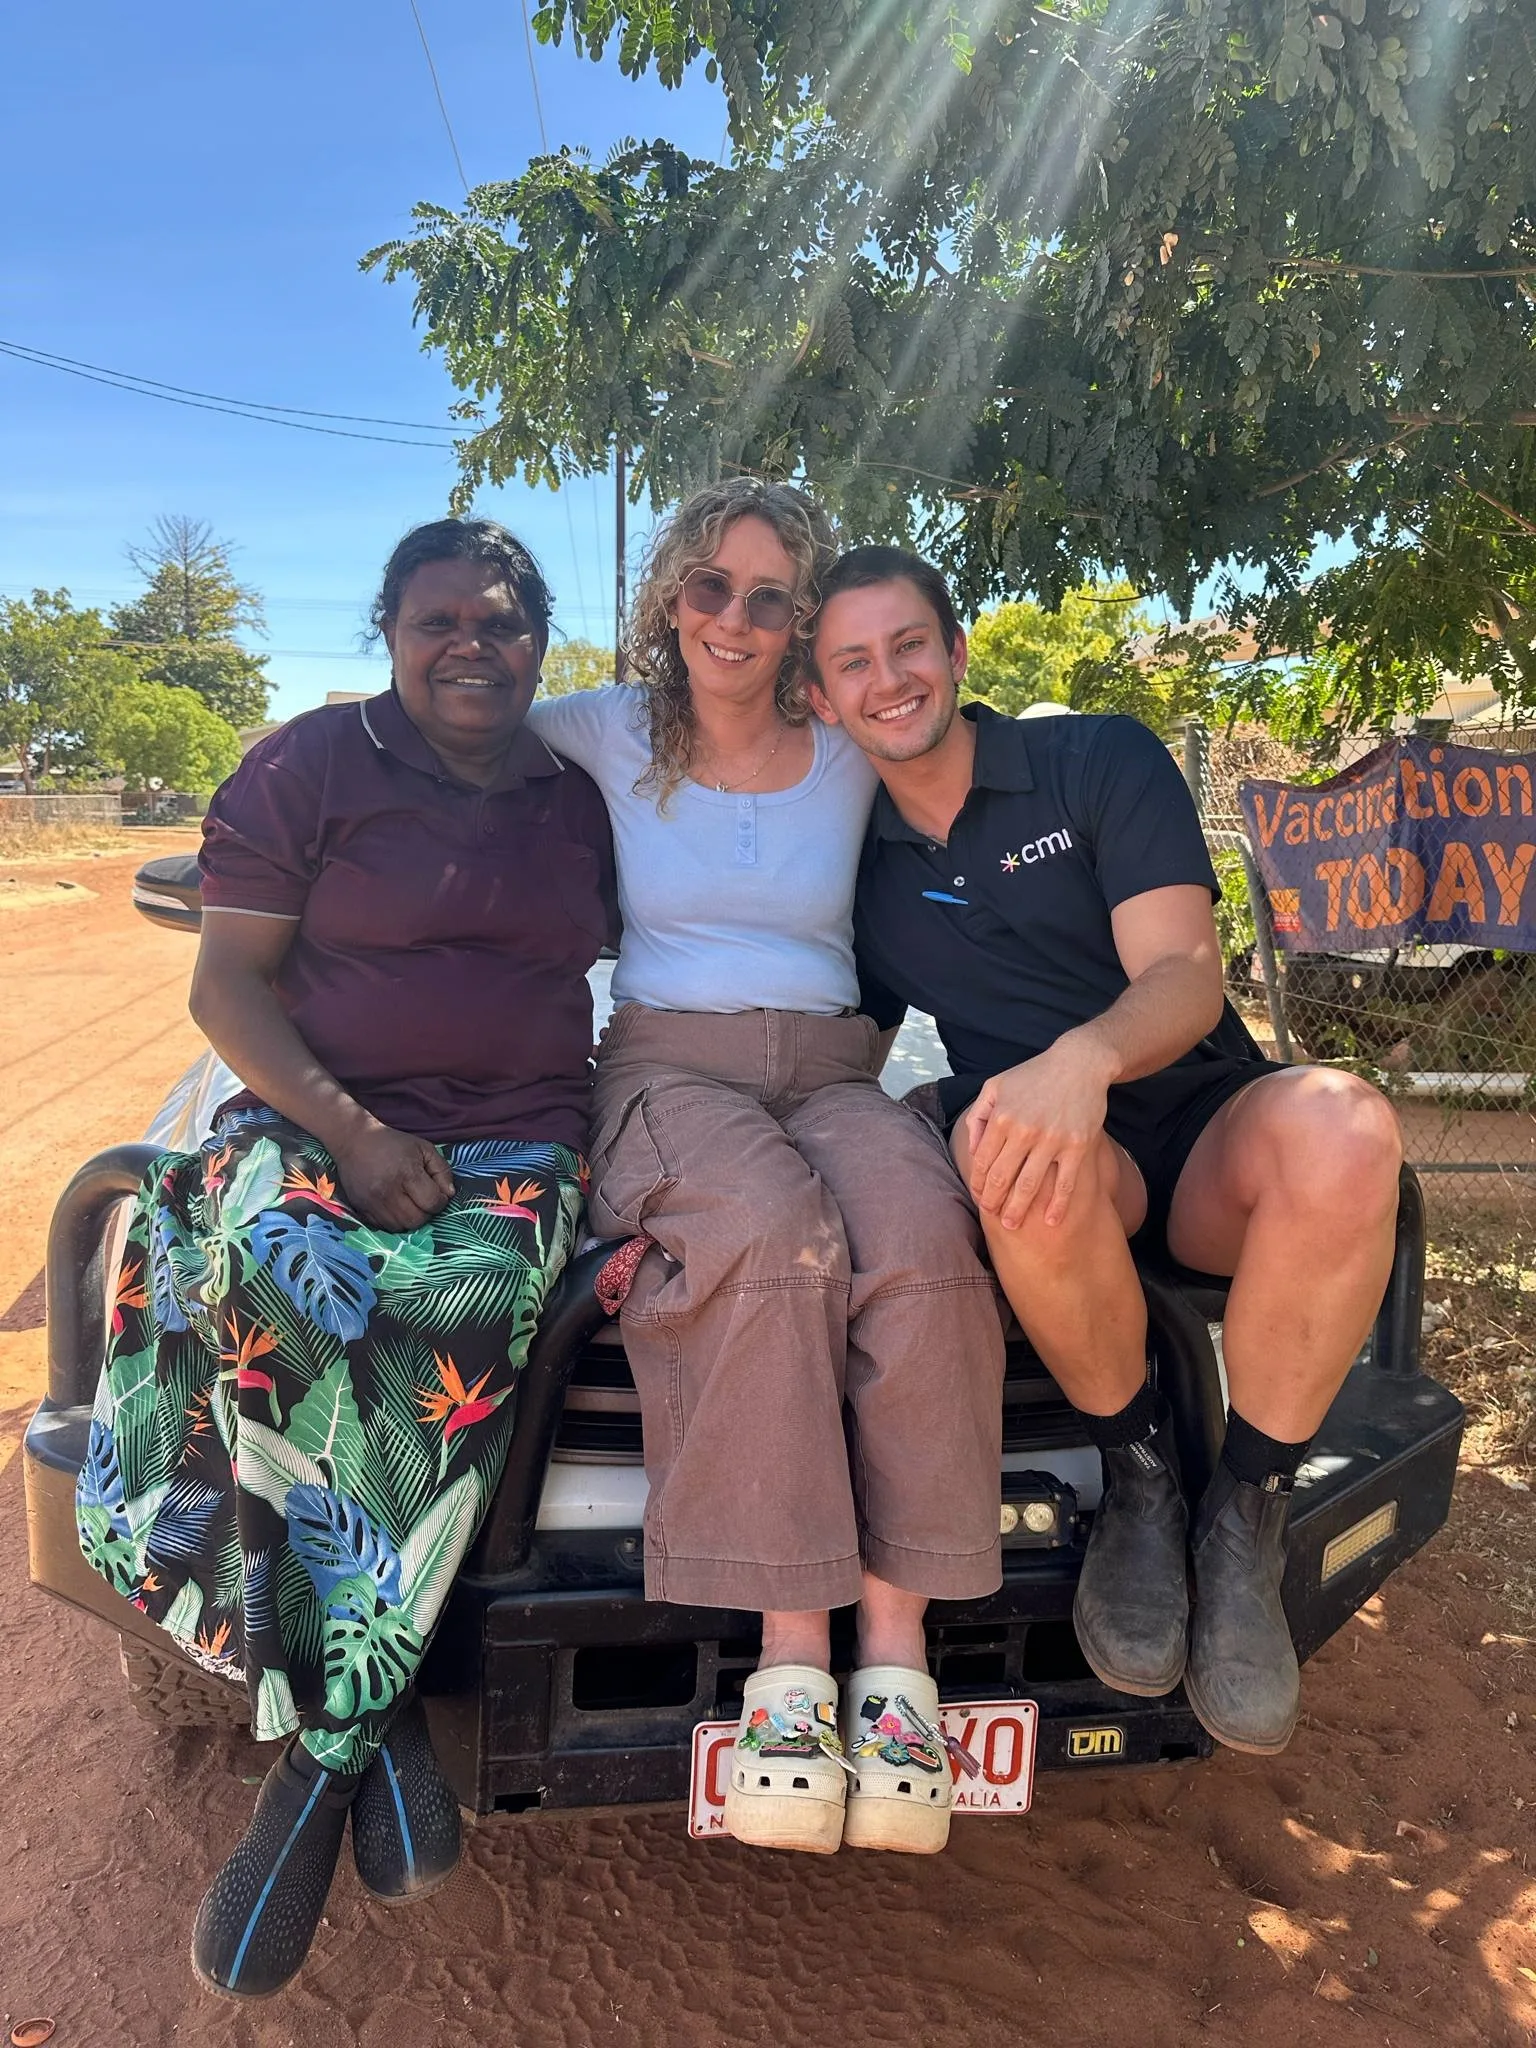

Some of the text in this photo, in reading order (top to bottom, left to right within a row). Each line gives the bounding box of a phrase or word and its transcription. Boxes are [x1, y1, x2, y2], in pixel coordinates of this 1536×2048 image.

[1253, 748, 1534, 849] Vaccination
[1315, 841, 1536, 932] TODAY
[956, 1792, 1001, 1806] ALIA
